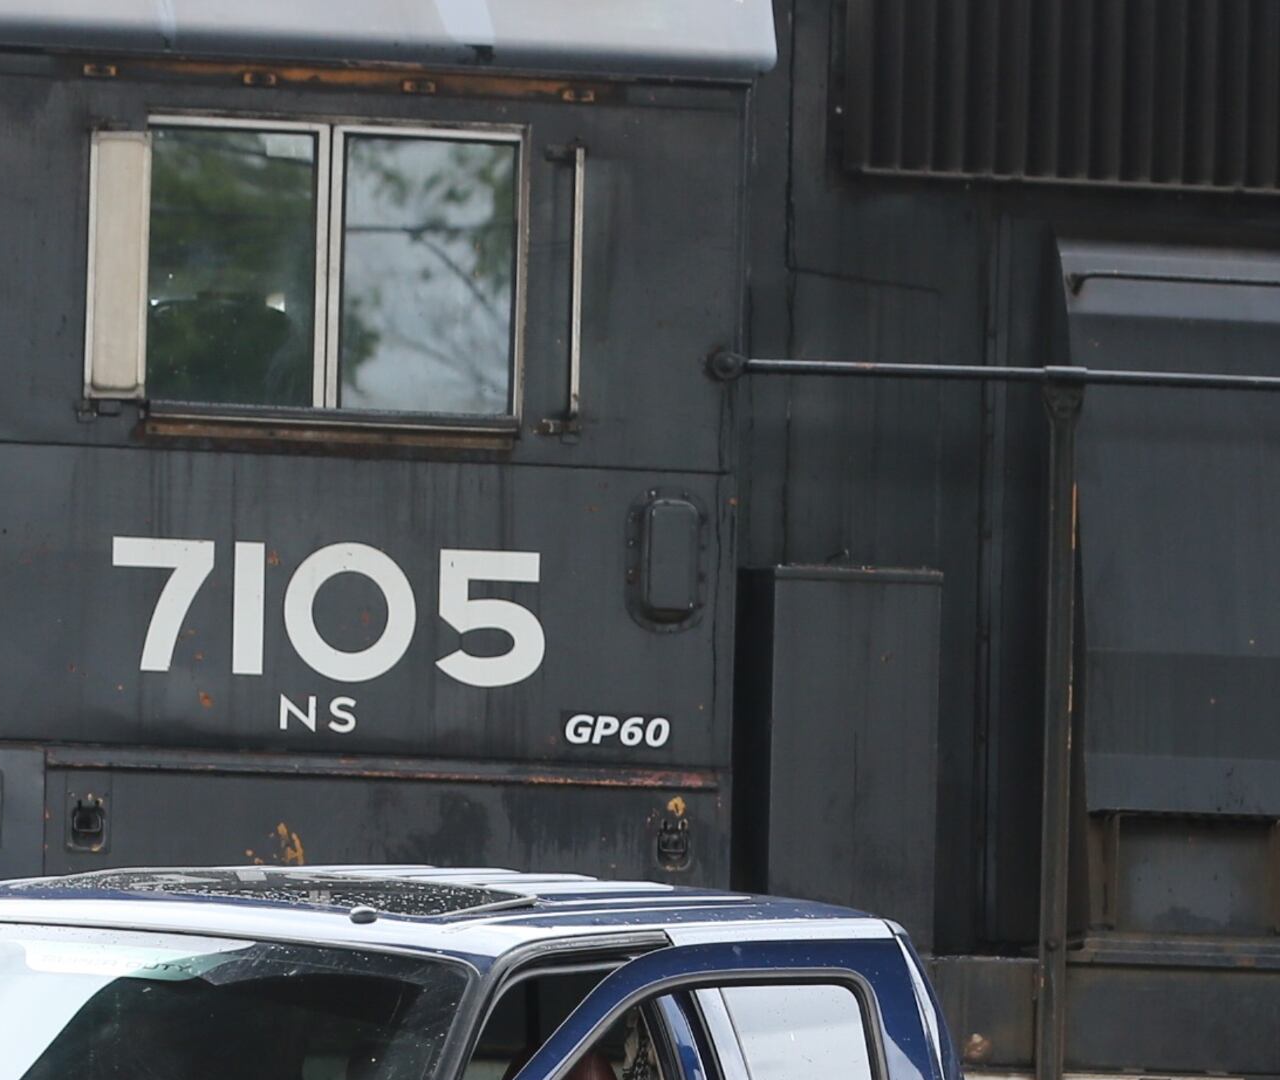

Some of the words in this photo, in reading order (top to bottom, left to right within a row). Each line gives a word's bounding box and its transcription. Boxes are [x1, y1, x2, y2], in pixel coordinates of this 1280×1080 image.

[112, 536, 546, 688] 7105
[279, 694, 357, 733] NS
[564, 713, 671, 748] GP60
